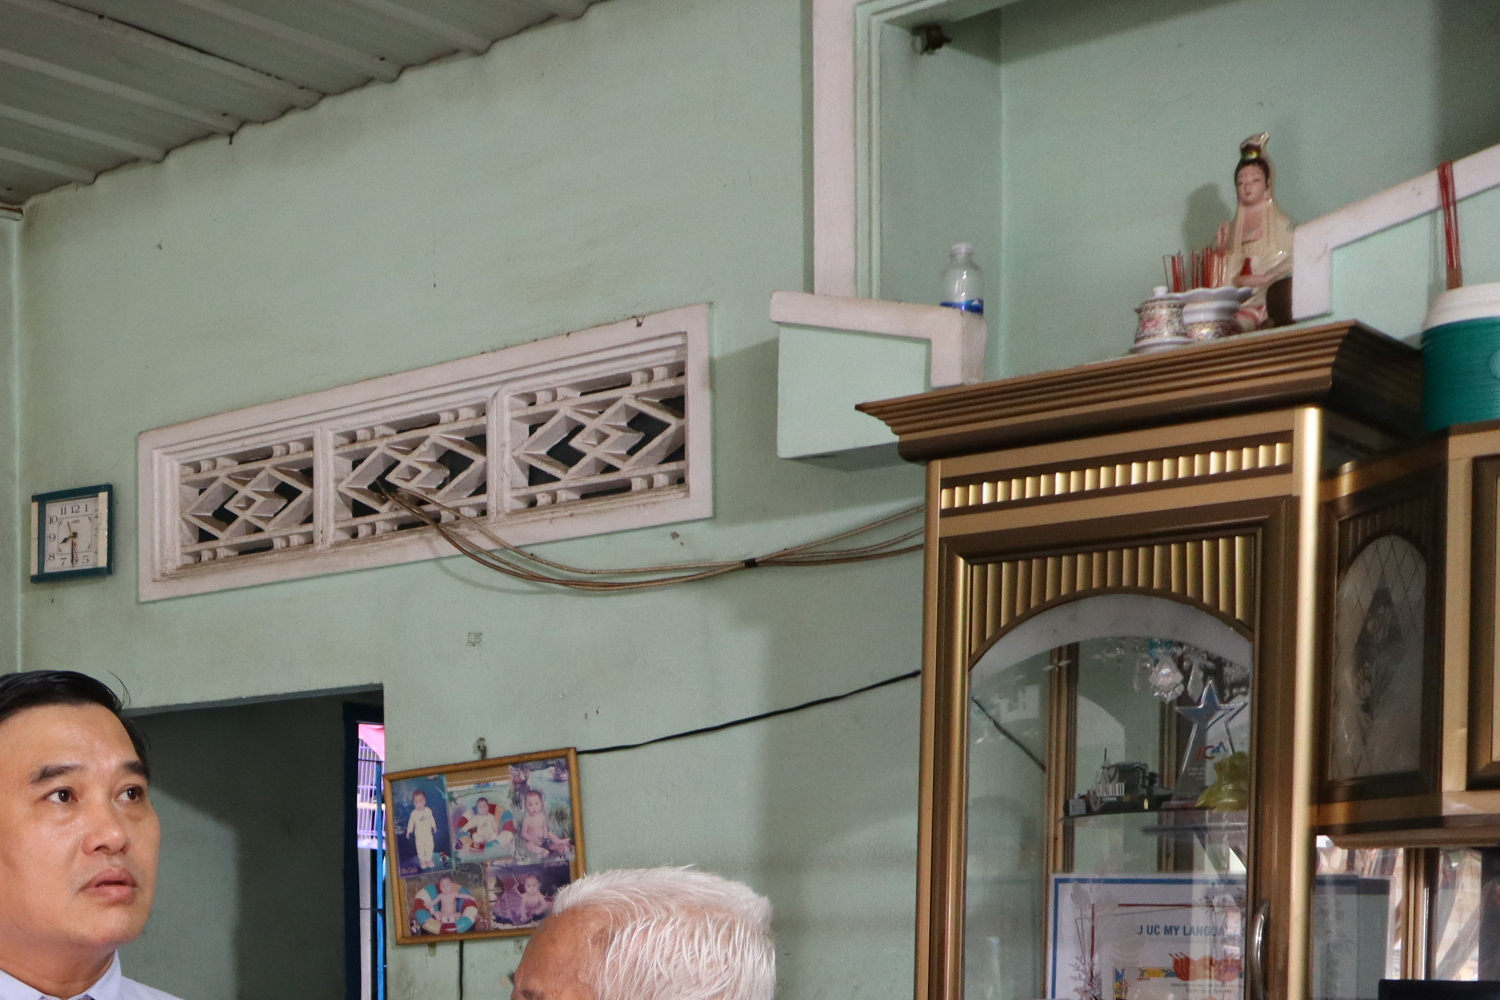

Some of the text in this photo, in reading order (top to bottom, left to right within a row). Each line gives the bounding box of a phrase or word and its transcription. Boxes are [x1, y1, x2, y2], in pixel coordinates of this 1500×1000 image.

[70, 504, 81, 514] 12
[48, 514, 58, 525] 10
[48, 533, 56, 542] 9
[48, 552, 55, 561] 8
[60, 557, 67, 566] 7
[82, 555, 90, 564] 5
